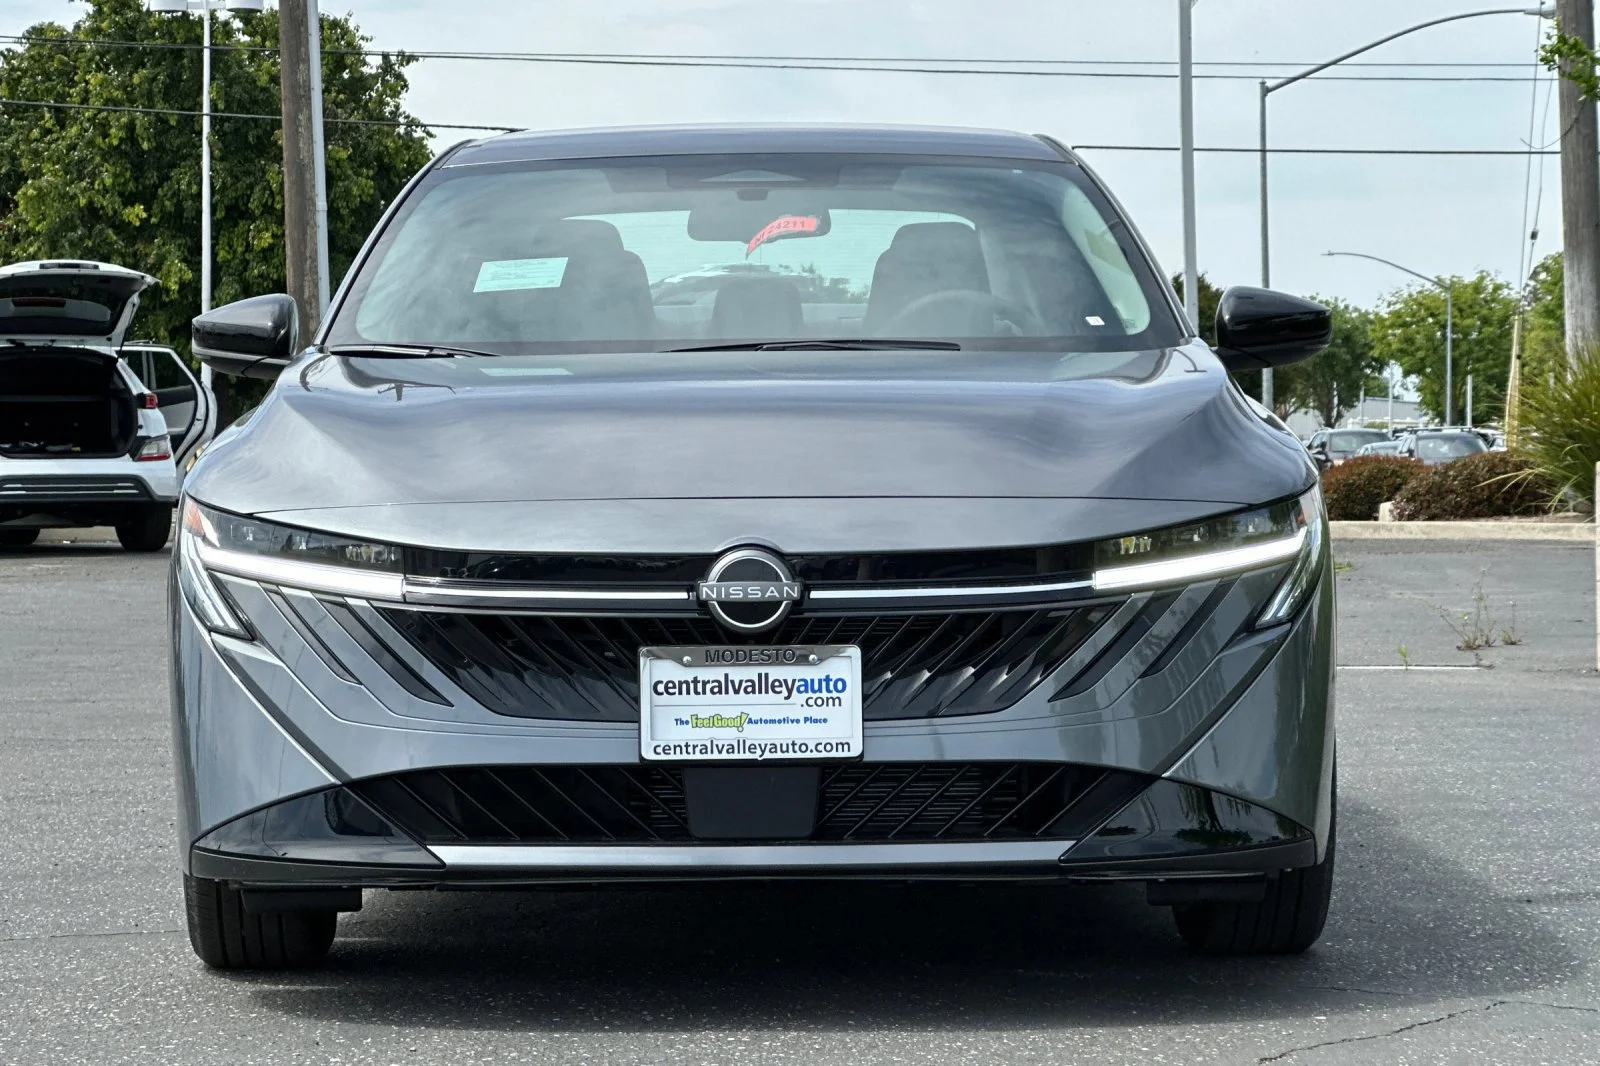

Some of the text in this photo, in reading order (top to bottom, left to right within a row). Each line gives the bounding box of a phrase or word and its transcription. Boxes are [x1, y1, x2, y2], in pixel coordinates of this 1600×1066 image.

[702, 585, 798, 599] NISSAN
[704, 648, 797, 664] MODESTO
[652, 672, 847, 700] centralvalleyauto
[800, 696, 842, 707] .com
[674, 718, 690, 726] The
[746, 716, 801, 725] Automotive
[803, 716, 828, 724] Place
[653, 739, 851, 758] centralvalleyauto.com
